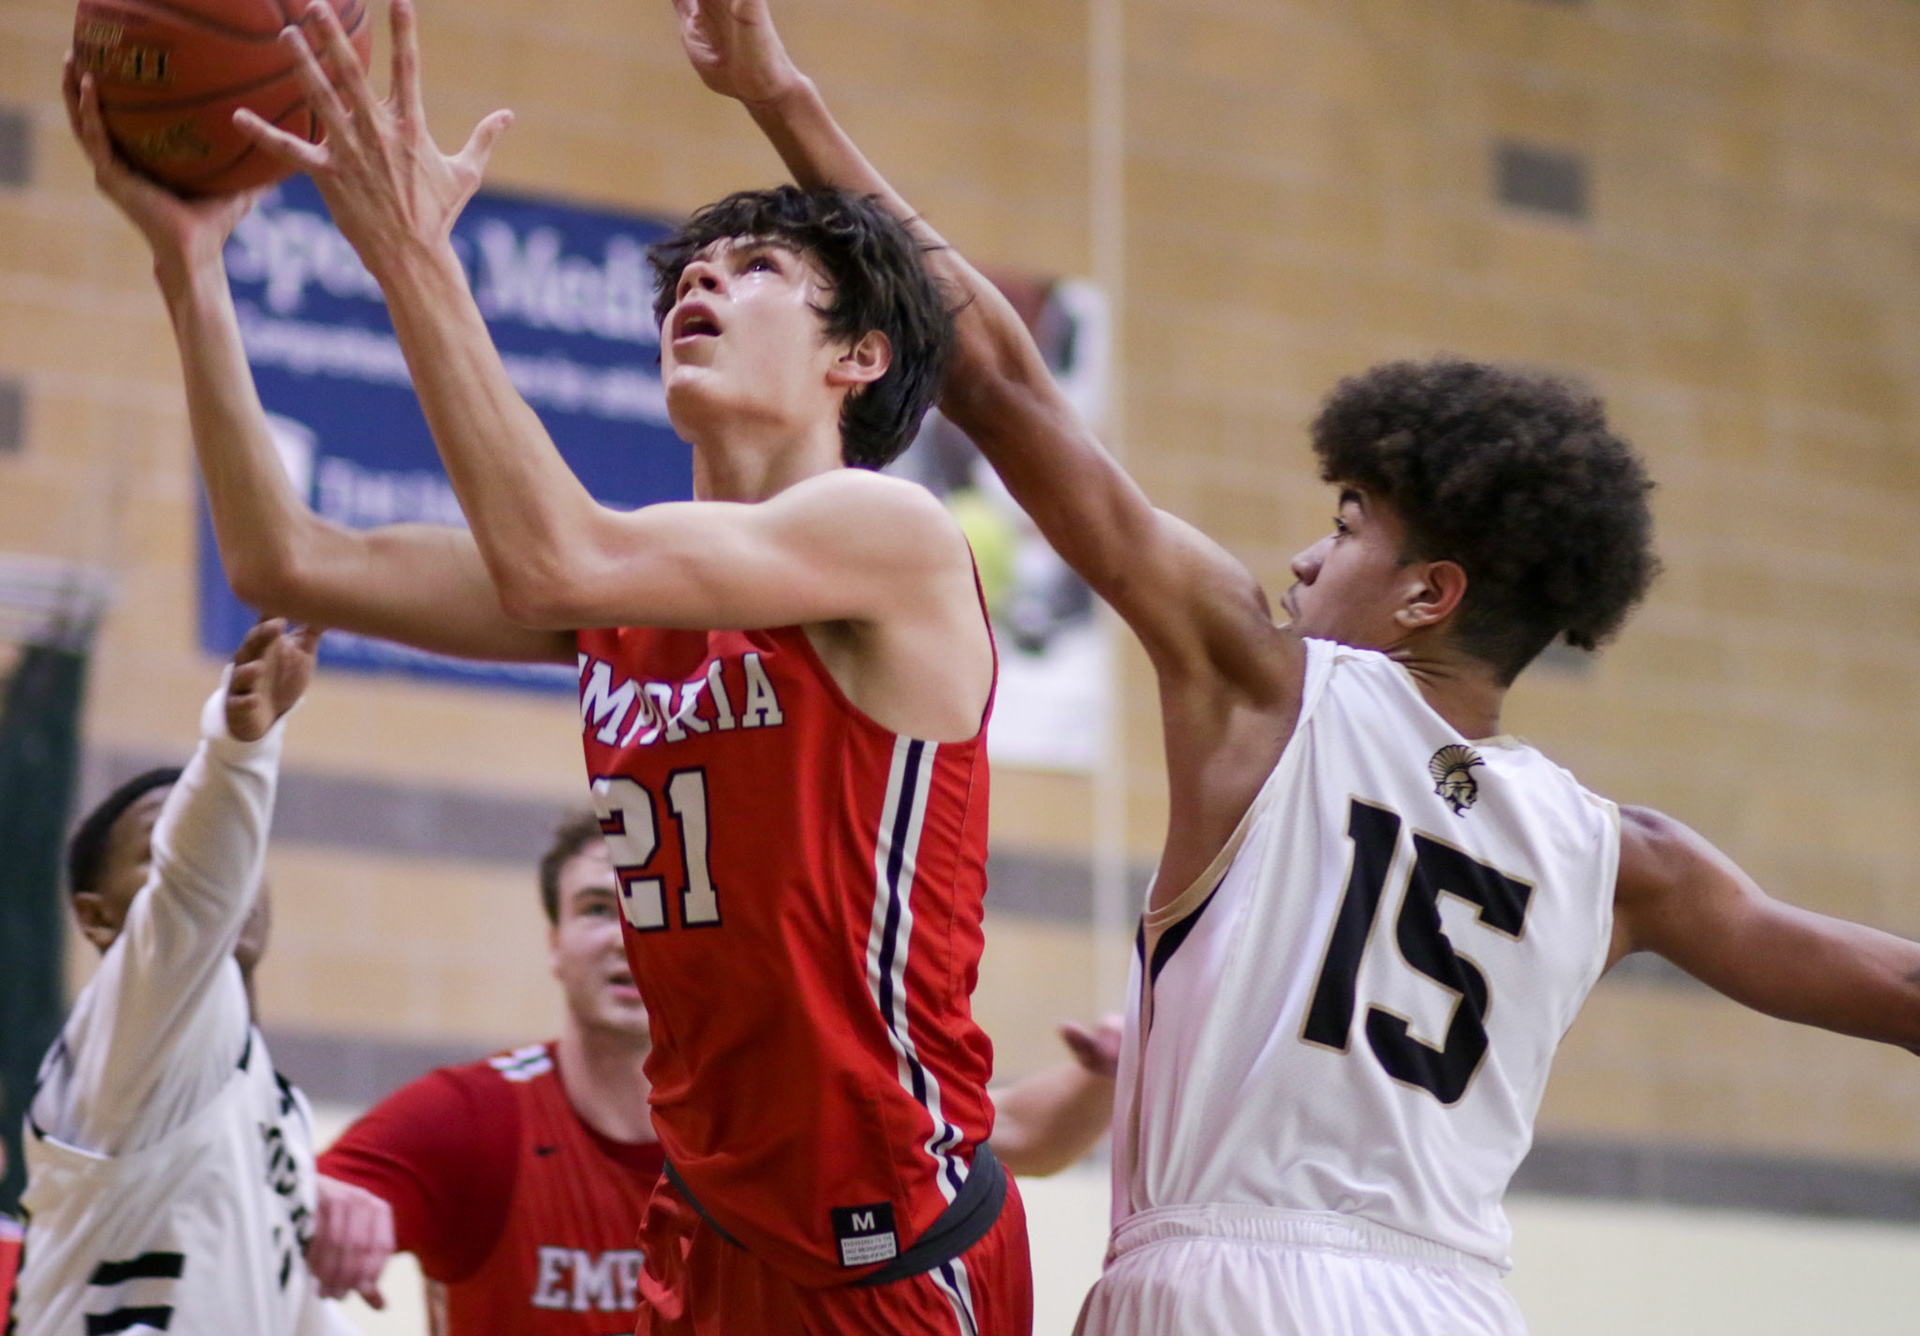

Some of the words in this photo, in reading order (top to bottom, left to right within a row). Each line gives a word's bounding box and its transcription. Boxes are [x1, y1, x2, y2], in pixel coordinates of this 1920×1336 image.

[591, 766, 722, 932] 21
[1298, 794, 1535, 1108] 15
[851, 1211, 875, 1231] M
